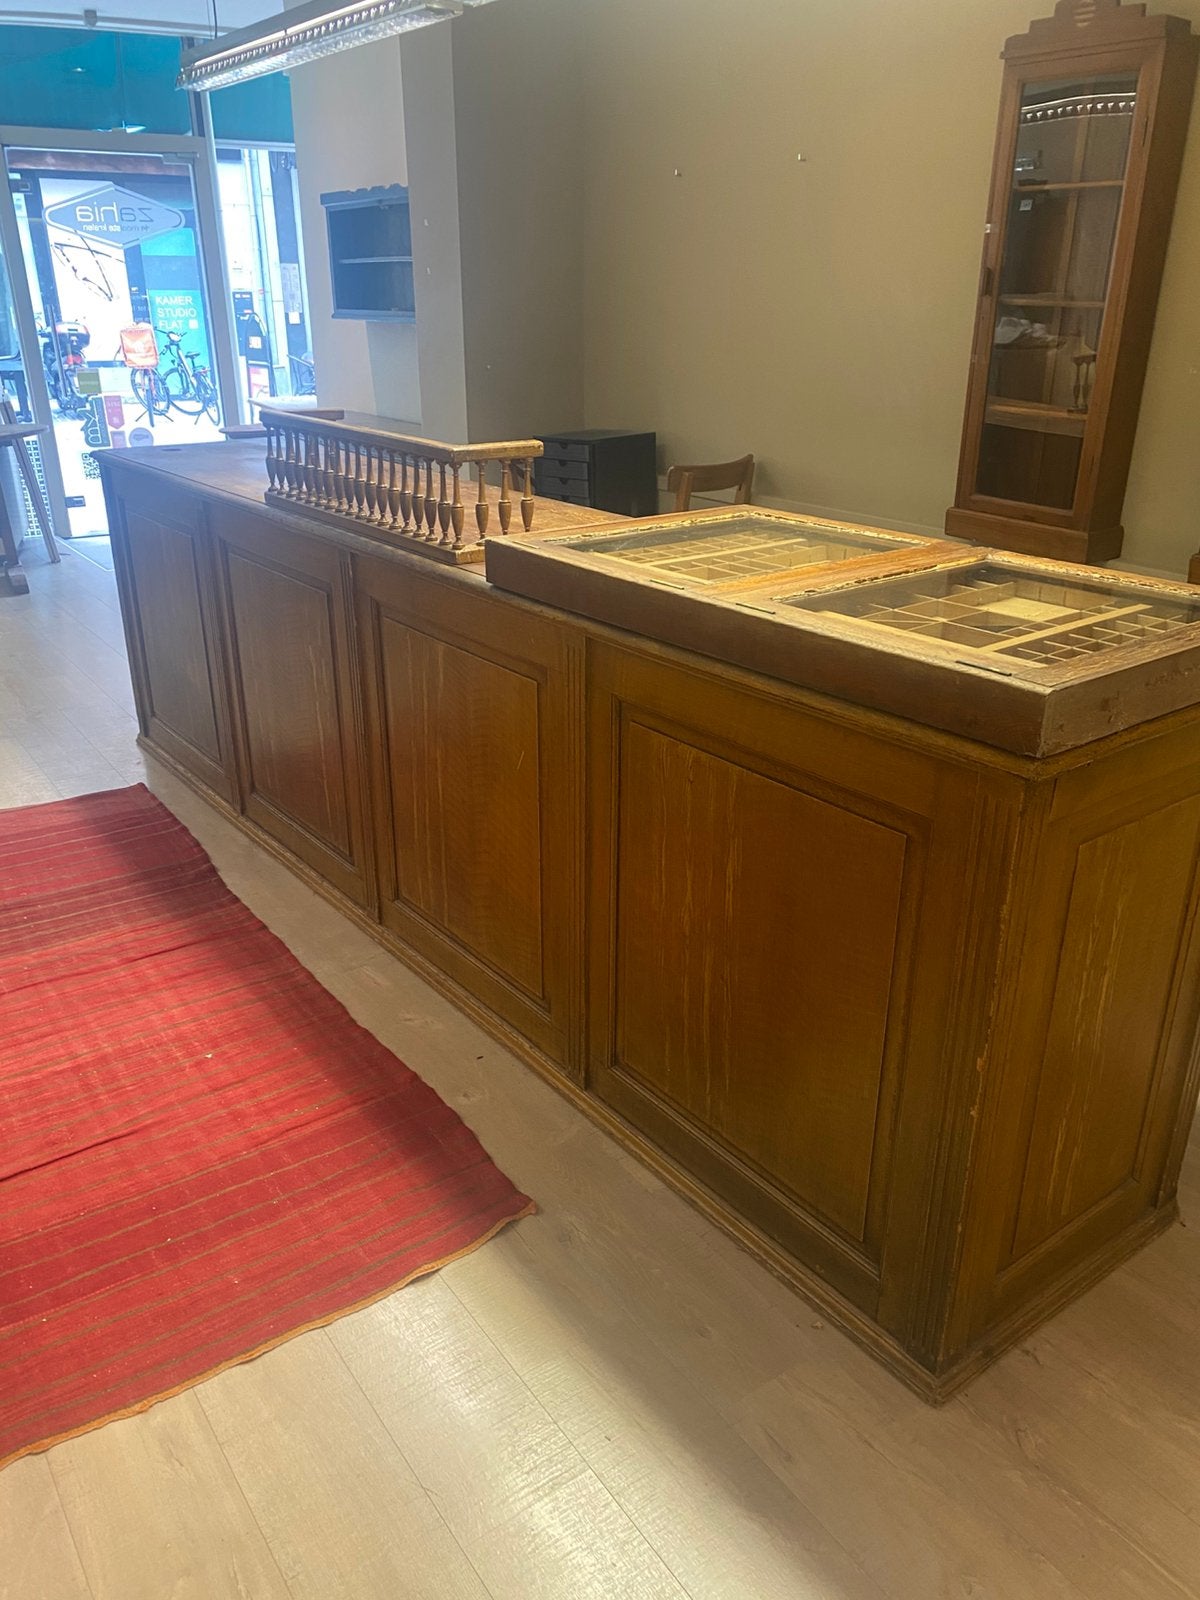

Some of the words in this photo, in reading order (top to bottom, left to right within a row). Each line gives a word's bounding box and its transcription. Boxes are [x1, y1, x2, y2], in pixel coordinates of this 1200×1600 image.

[155, 295, 193, 306] KAMER
[157, 307, 197, 318] STUDIO
[159, 319, 184, 330] FLAT
